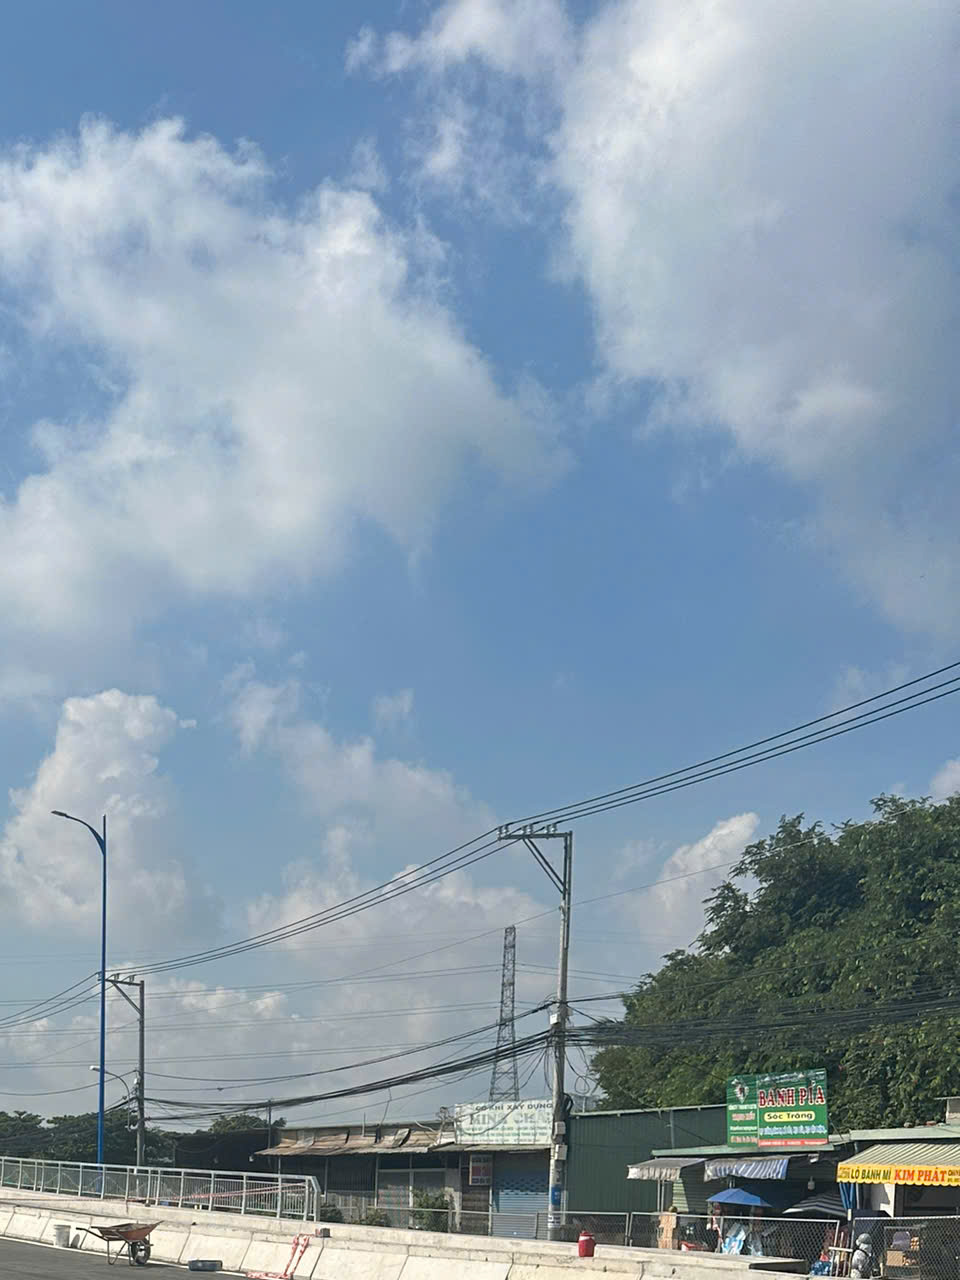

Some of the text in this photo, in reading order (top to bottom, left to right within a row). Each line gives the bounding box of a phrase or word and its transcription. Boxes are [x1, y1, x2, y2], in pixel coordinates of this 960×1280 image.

[861, 1166, 881, 1180] BÁNH
[894, 1169, 915, 1181] KIM
[917, 1166, 948, 1182] PHÁT
